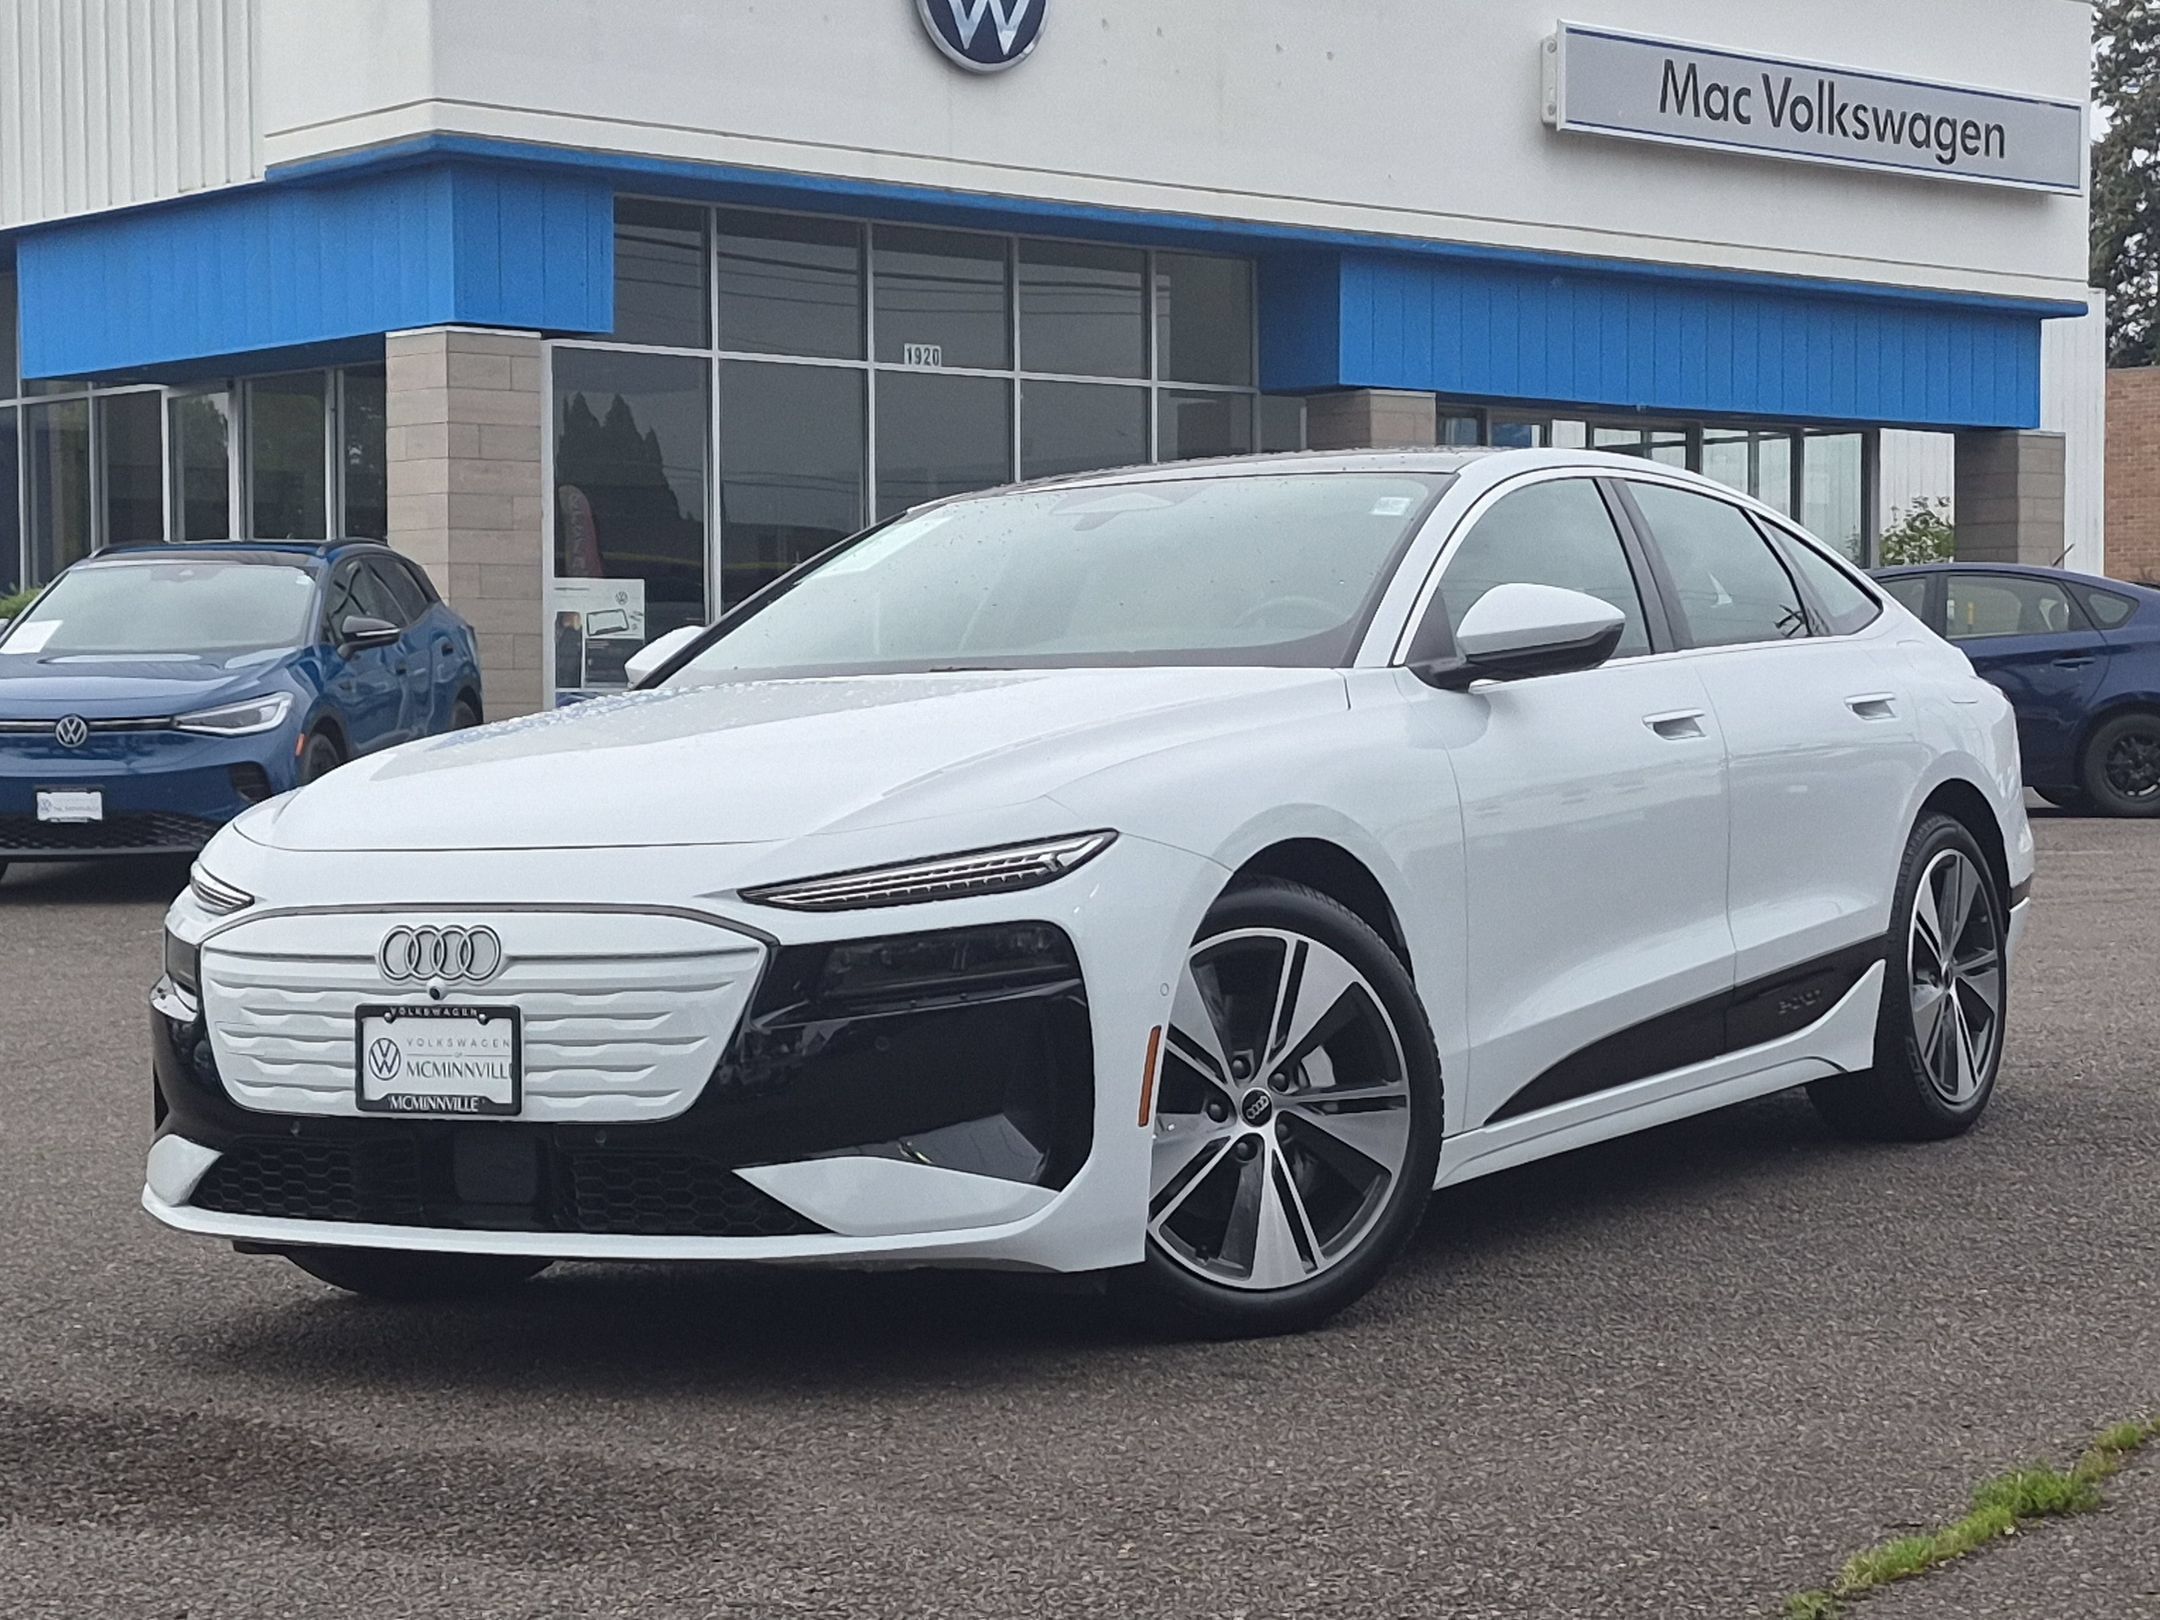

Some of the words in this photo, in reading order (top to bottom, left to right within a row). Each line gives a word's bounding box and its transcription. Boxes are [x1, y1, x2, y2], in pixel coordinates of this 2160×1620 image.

[1659, 59, 1752, 126] Mac
[1761, 73, 2006, 165] Volkswagen
[907, 347, 940, 366] 1920
[406, 1038, 510, 1048] VOLKSWAGEN
[389, 1095, 479, 1112] MCMINNVILLE
